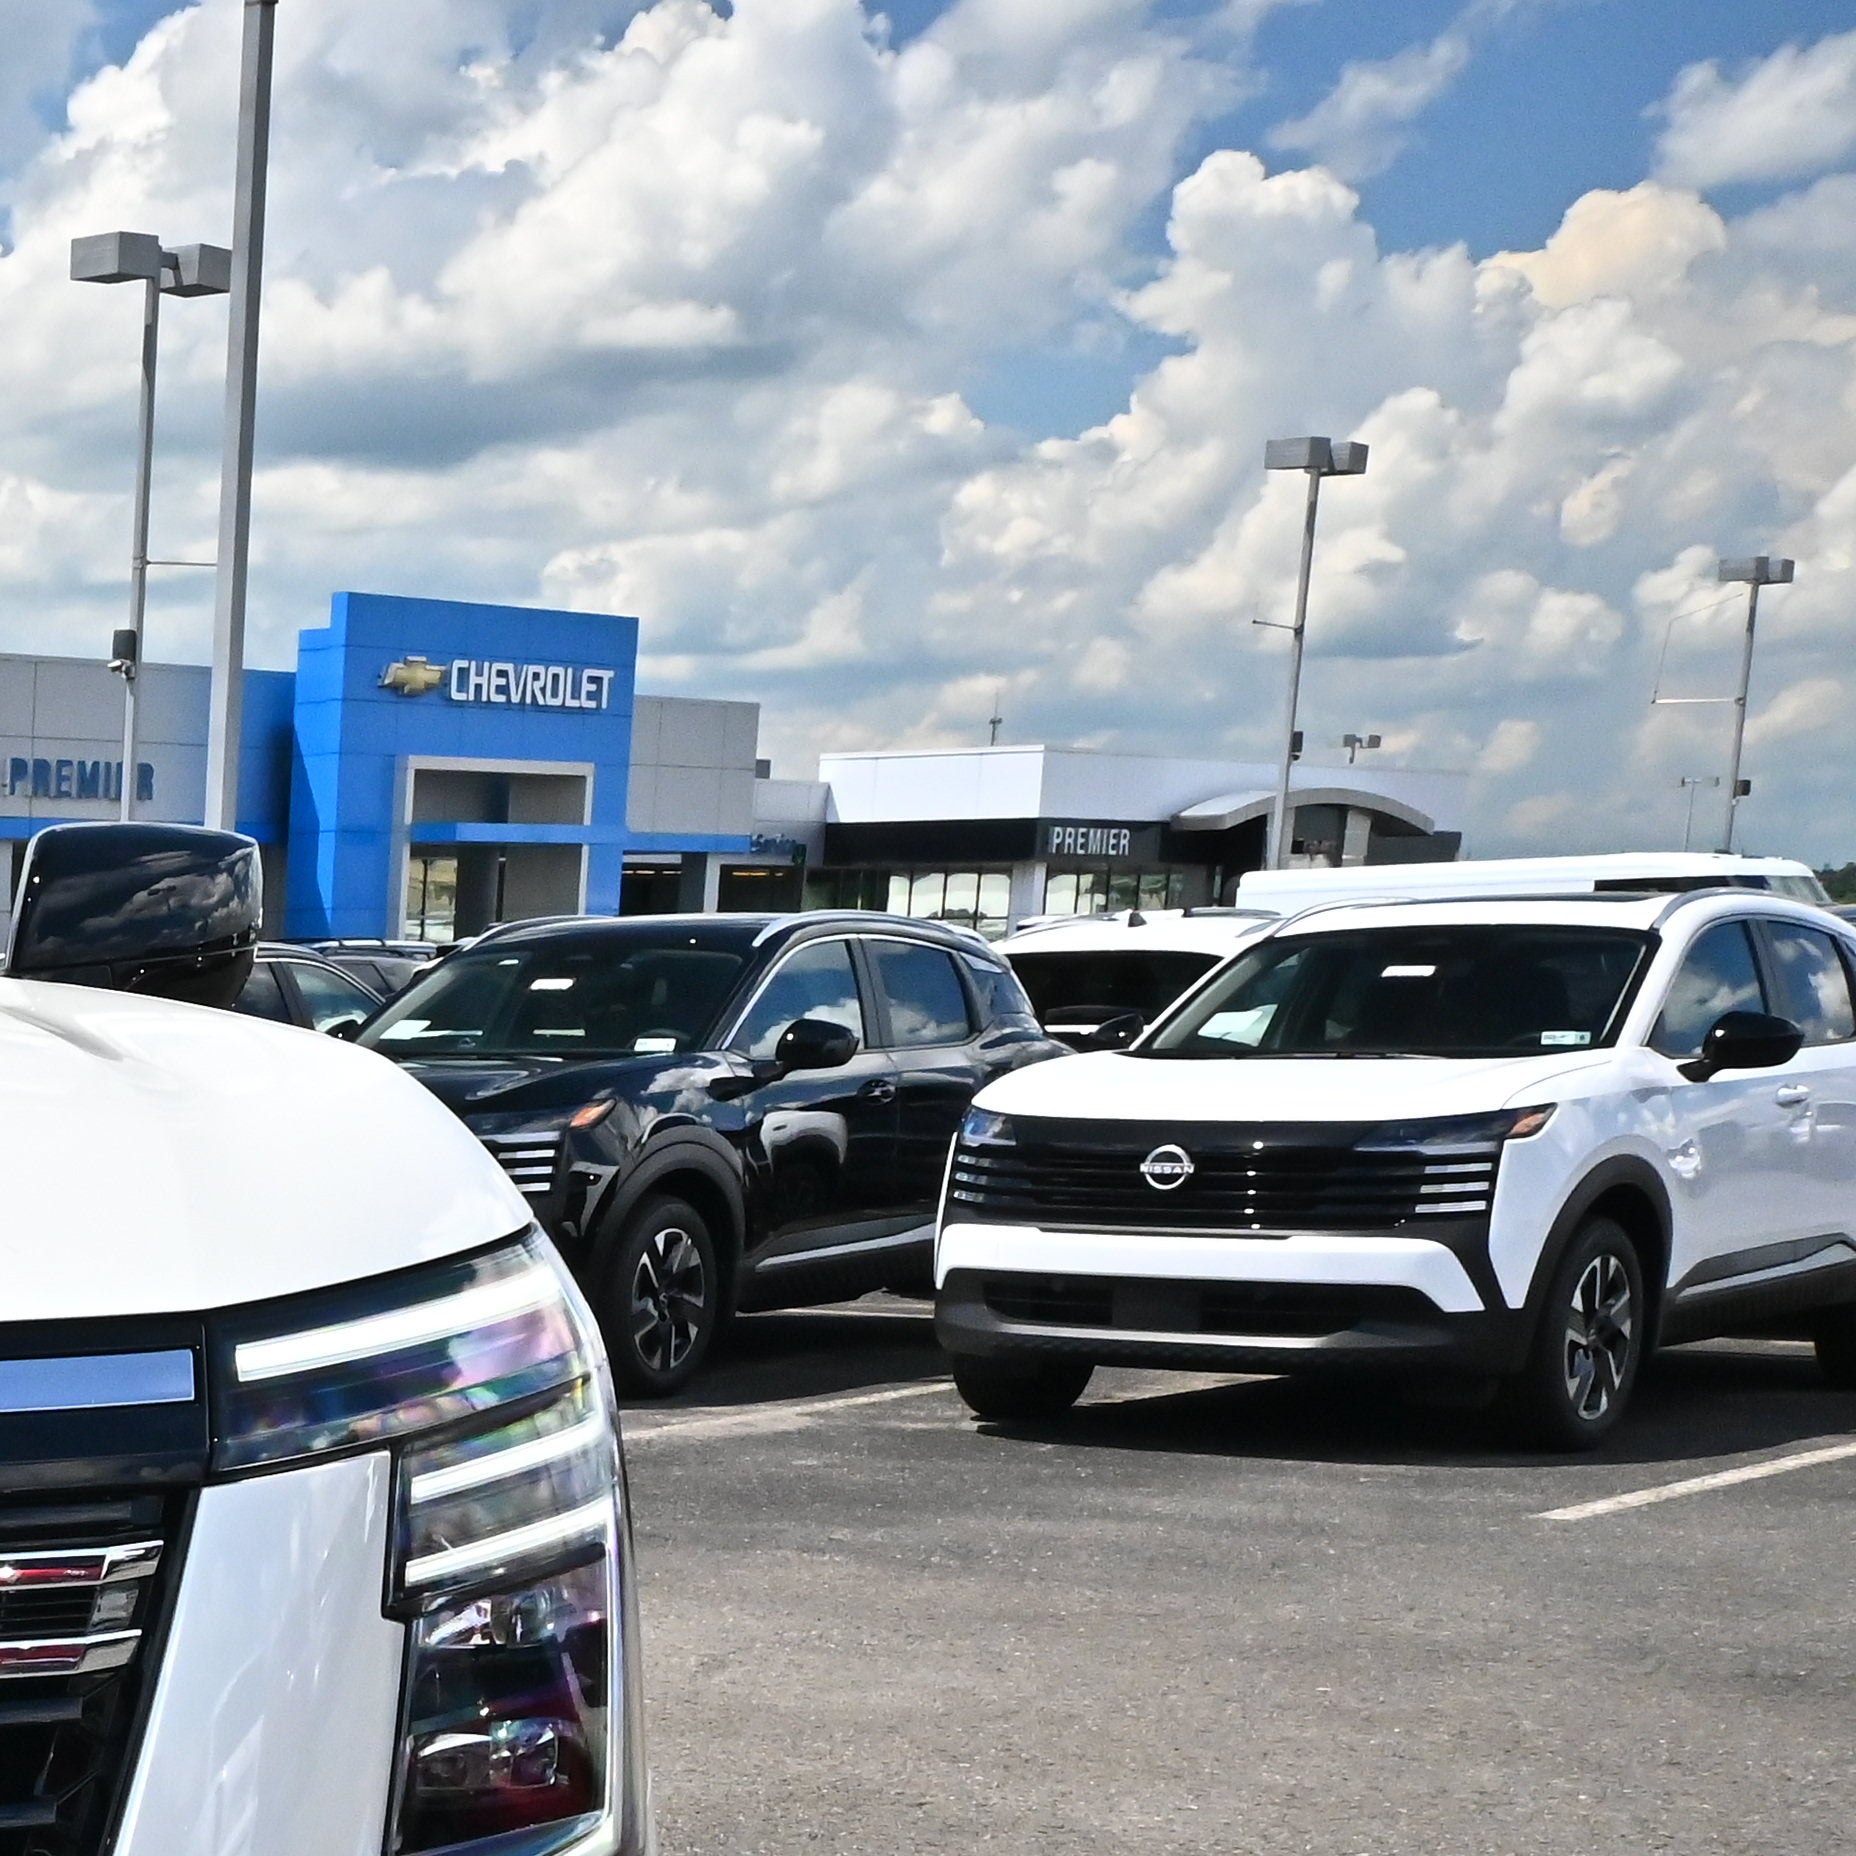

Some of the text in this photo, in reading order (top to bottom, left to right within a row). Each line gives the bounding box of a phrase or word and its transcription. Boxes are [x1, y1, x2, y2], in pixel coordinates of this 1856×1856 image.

[450, 659, 615, 709] CHEVROLET
[1052, 826, 1131, 856] PREMIER
[1139, 1162, 1195, 1174] NISSAN
